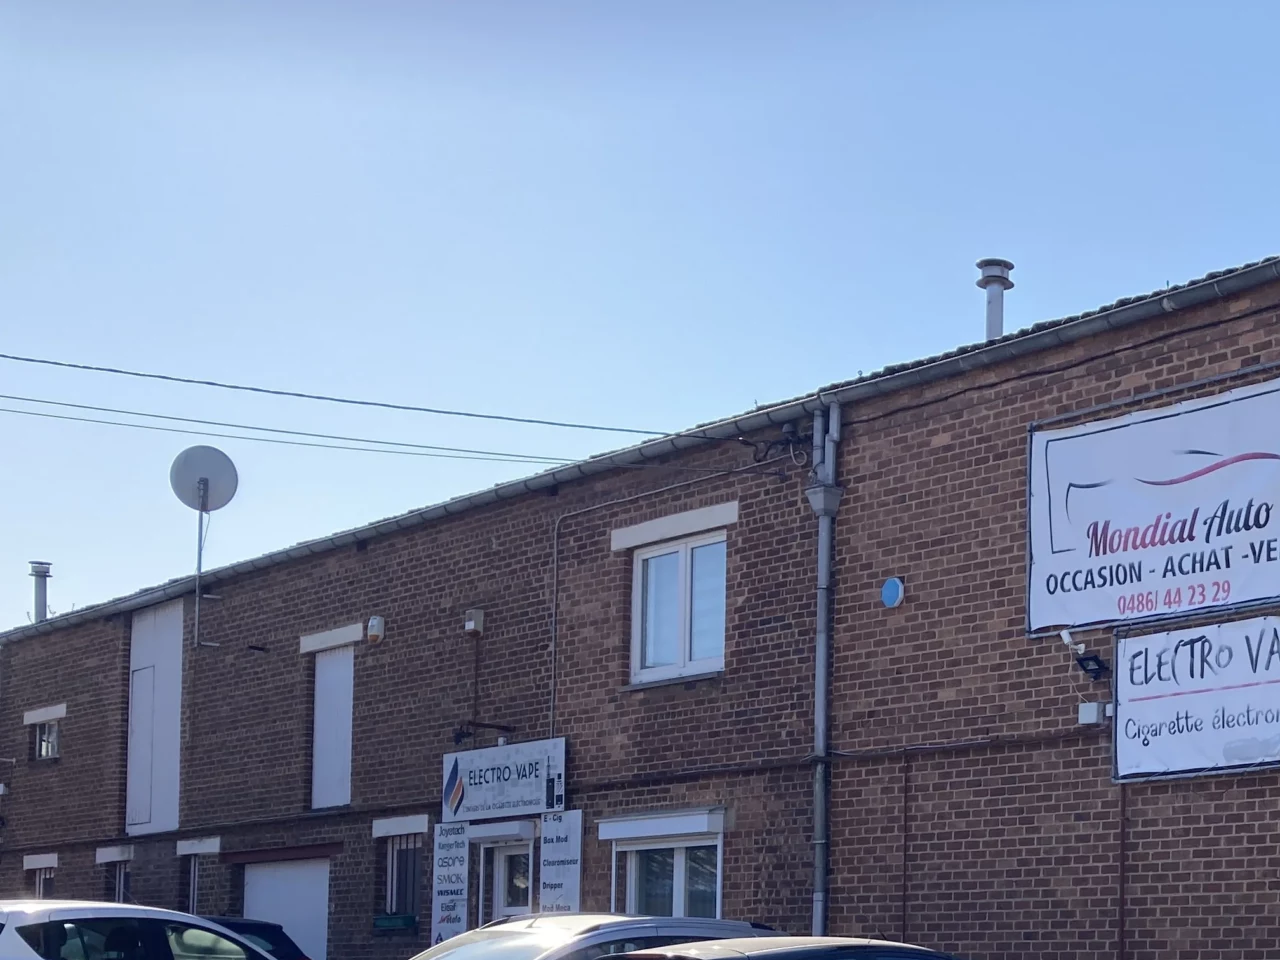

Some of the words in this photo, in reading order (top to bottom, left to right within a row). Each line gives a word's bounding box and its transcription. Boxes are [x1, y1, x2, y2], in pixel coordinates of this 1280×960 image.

[1087, 506, 1200, 558] Mondial
[1203, 499, 1274, 543] Auto
[1046, 561, 1142, 594] OCCASION
[1162, 545, 1233, 579] ACHAT
[1118, 589, 1159, 615] 0486/
[1163, 587, 1183, 608] 44
[1187, 584, 1207, 605] 23
[1211, 581, 1231, 602] 29
[1125, 710, 1204, 747] Cigarette
[469, 766, 511, 786] ELECTRO
[516, 761, 540, 780] VAPE
[552, 813, 562, 823] Cig
[543, 836, 554, 844] Box
[556, 835, 568, 843] Mod
[543, 859, 578, 867] Clearomiseur
[437, 874, 464, 884] SMOK
[542, 882, 563, 891] Dripper
